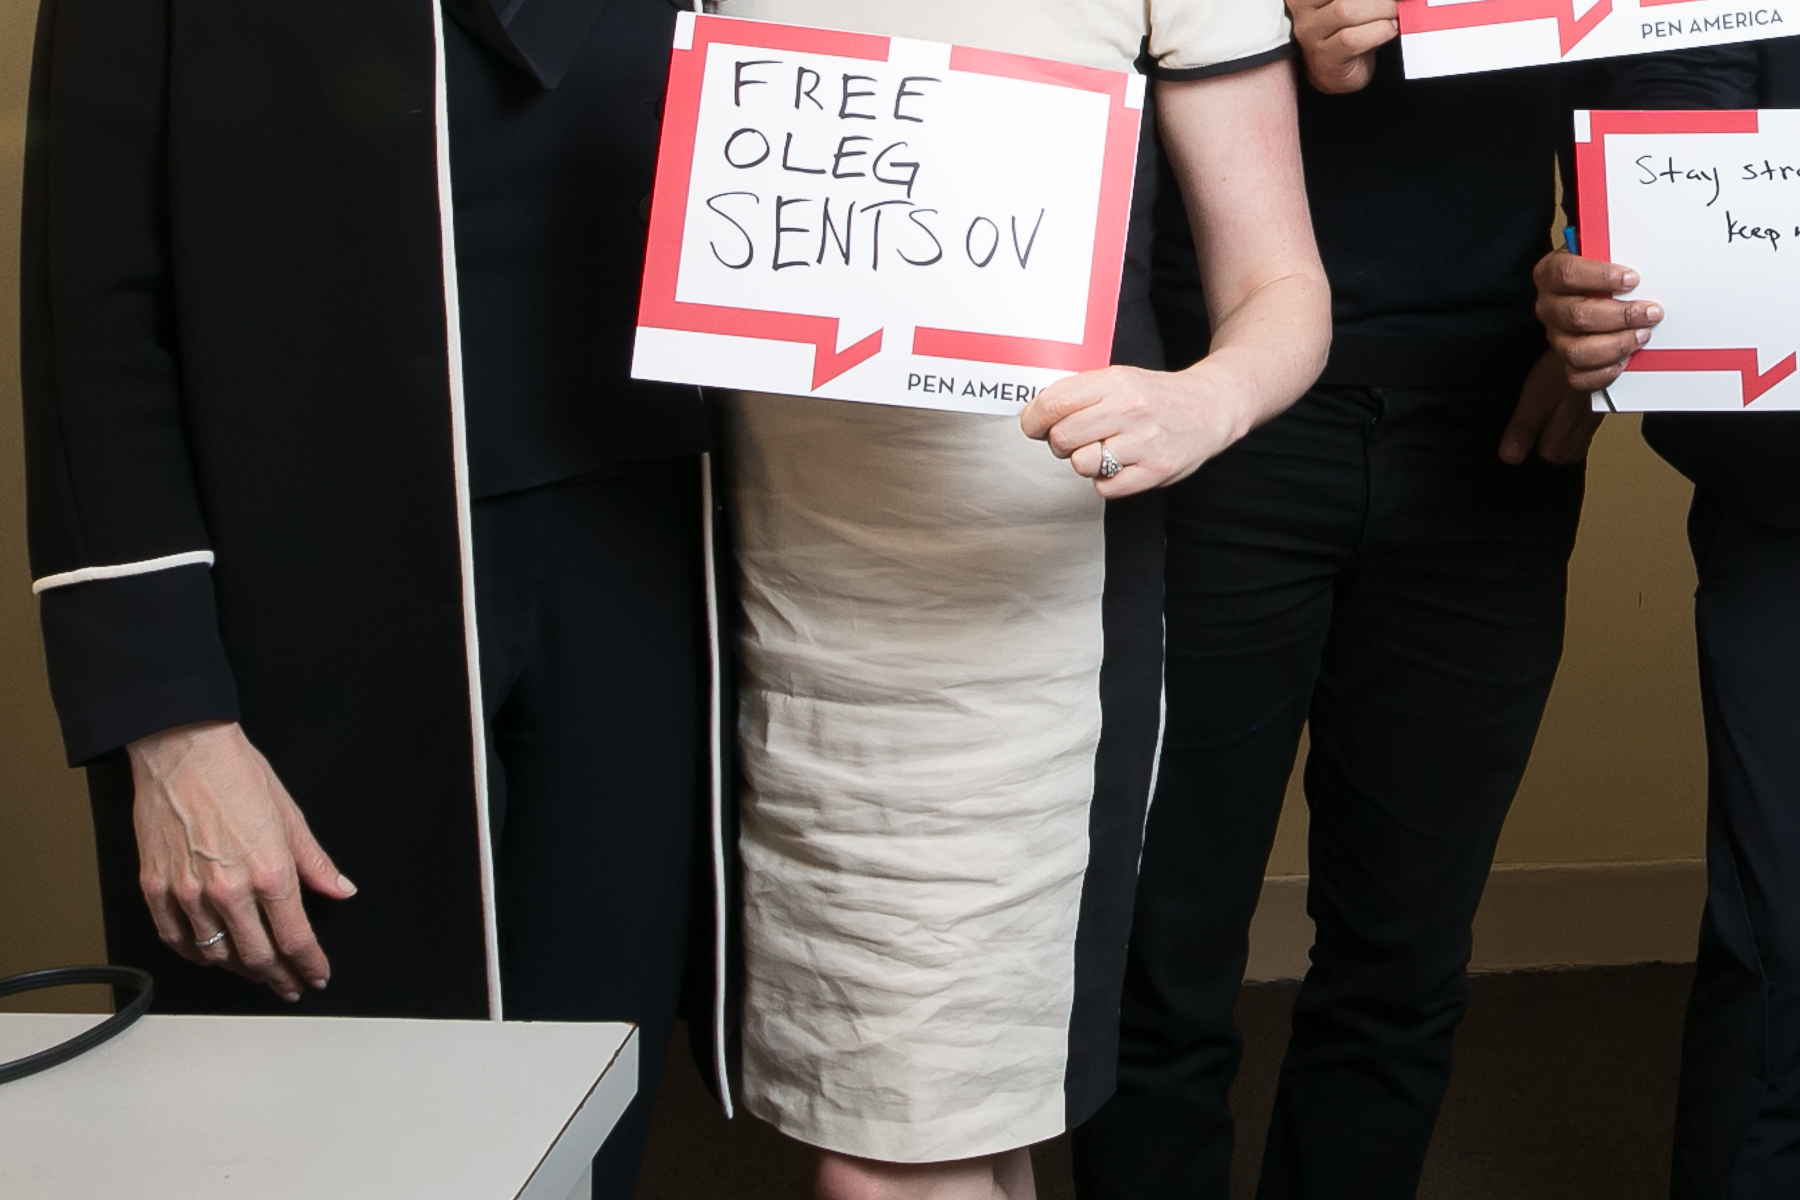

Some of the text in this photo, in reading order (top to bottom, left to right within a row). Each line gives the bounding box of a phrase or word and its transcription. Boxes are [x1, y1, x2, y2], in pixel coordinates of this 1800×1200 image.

[1641, 9, 1784, 40] PEN AMERICA
[734, 60, 942, 123] FREE
[723, 127, 920, 199] OLEG
[1635, 155, 1720, 207] Stay
[705, 190, 1045, 272] SENTSOV
[907, 372, 955, 395] PEN
